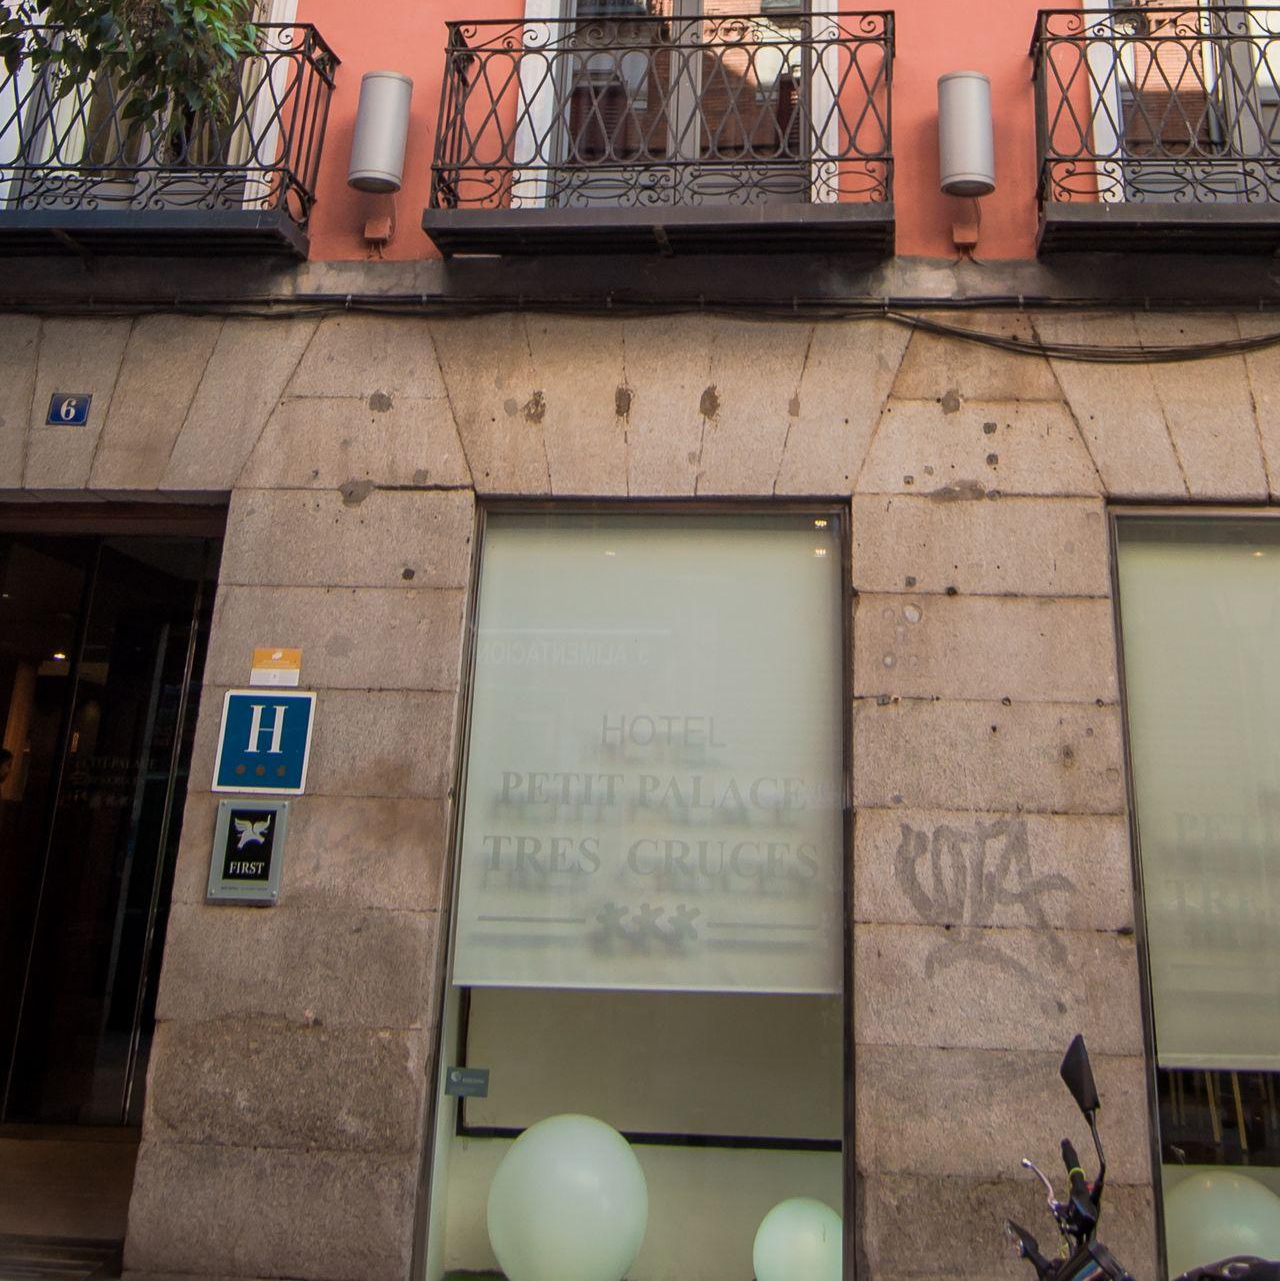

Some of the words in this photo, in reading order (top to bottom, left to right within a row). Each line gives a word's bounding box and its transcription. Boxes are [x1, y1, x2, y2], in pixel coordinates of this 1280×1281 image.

[60, 397, 77, 421] 6
[243, 704, 289, 754] H
[601, 714, 727, 748] HOTEL
[499, 770, 625, 807] PETIT
[637, 773, 808, 811] PALACE
[228, 861, 265, 874] FIRST
[482, 834, 602, 874] TRES
[626, 837, 819, 880] CRUCES
